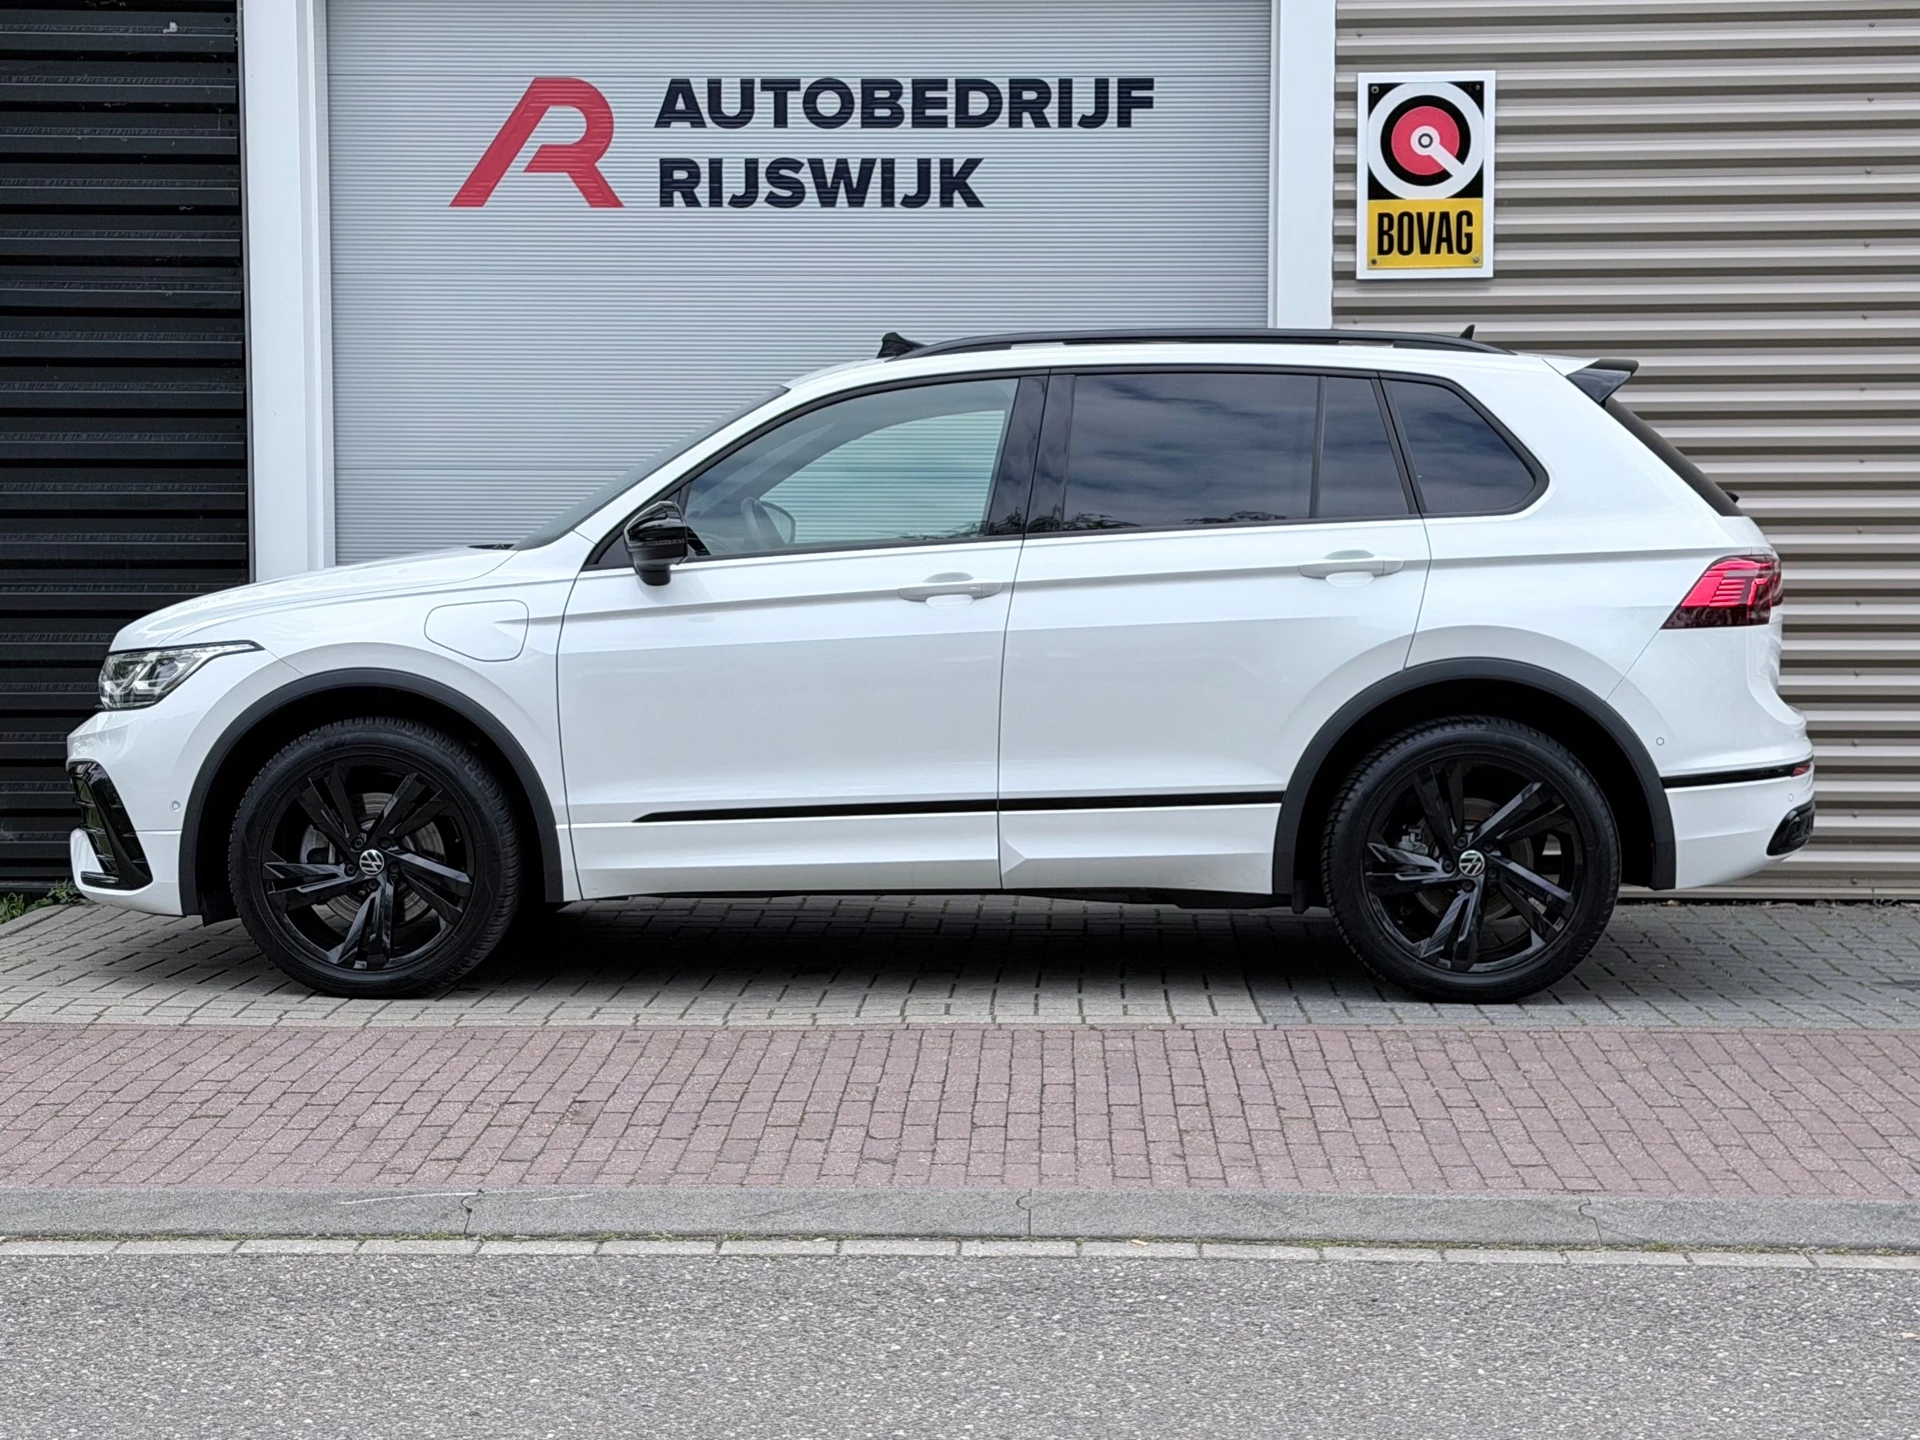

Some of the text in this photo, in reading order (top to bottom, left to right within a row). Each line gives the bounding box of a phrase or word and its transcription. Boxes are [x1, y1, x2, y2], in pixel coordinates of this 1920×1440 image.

[654, 77, 1155, 130] AUTOBEDRIJF
[659, 157, 985, 209] RIJSWIJK
[1377, 210, 1473, 256] BOVAG
